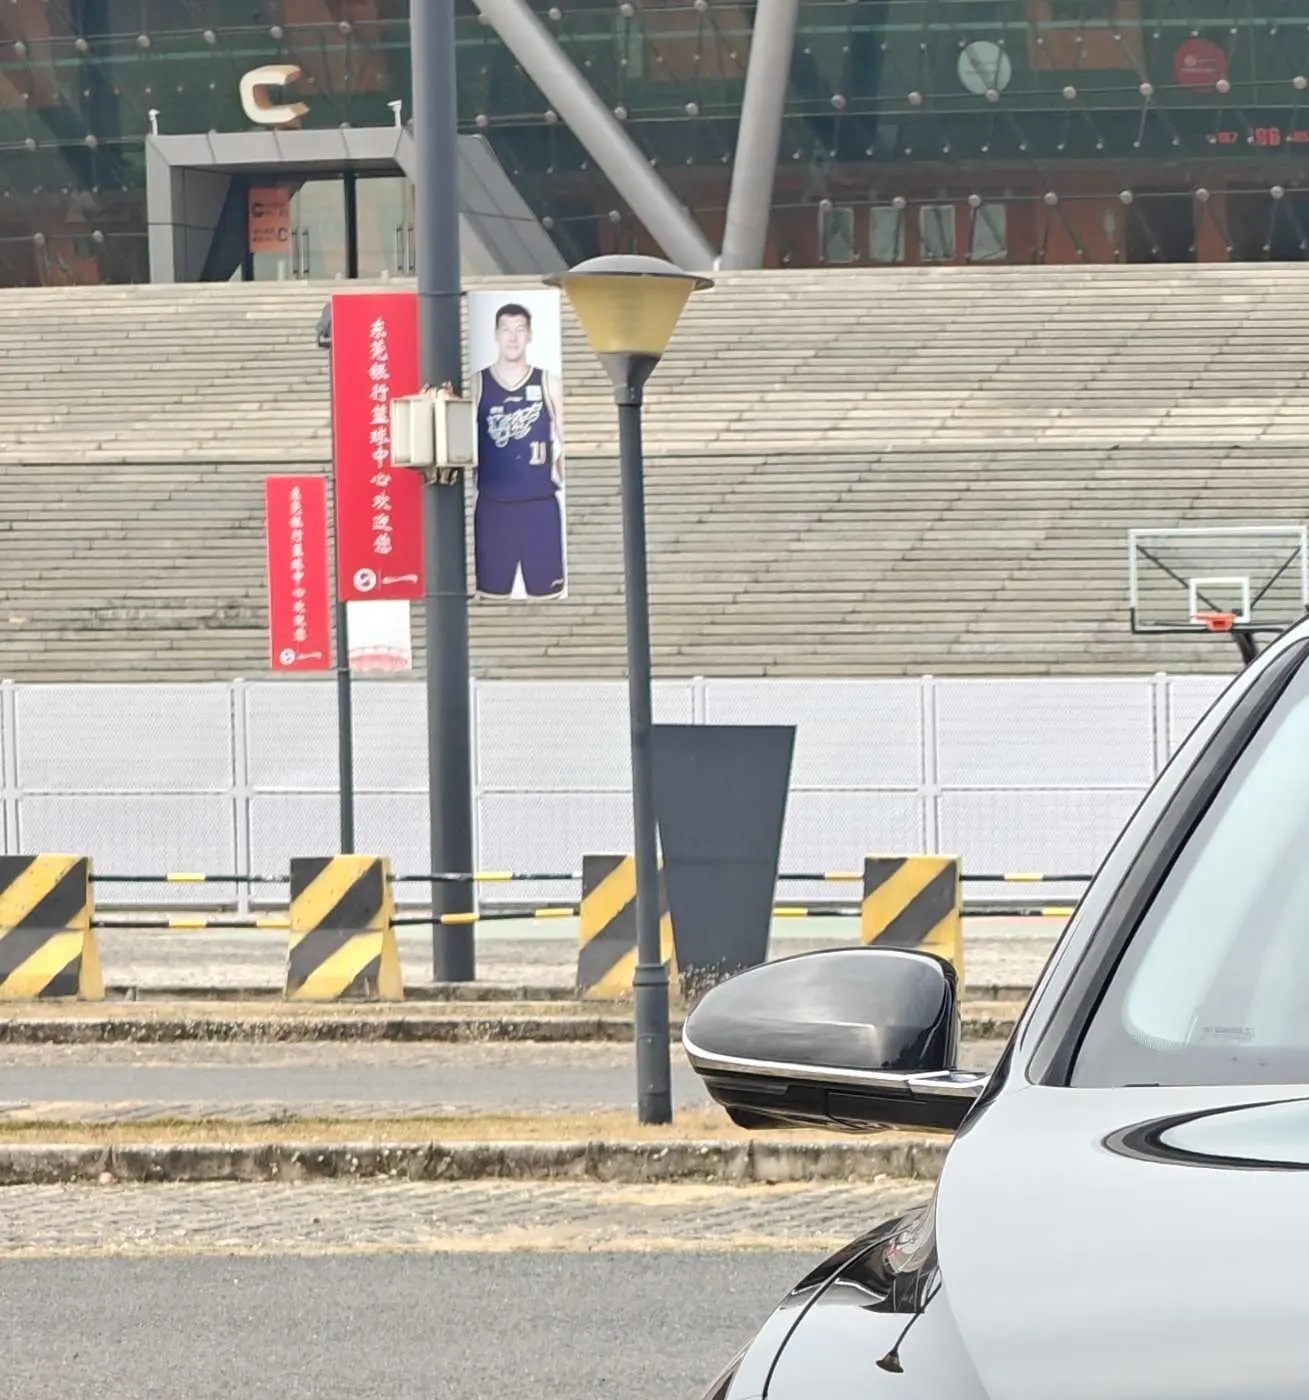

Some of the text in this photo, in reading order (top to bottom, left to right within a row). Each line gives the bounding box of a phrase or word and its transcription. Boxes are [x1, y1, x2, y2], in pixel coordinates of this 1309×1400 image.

[239, 64, 309, 124] C
[367, 316, 393, 555] 东莞银行篮球中心欢迎您
